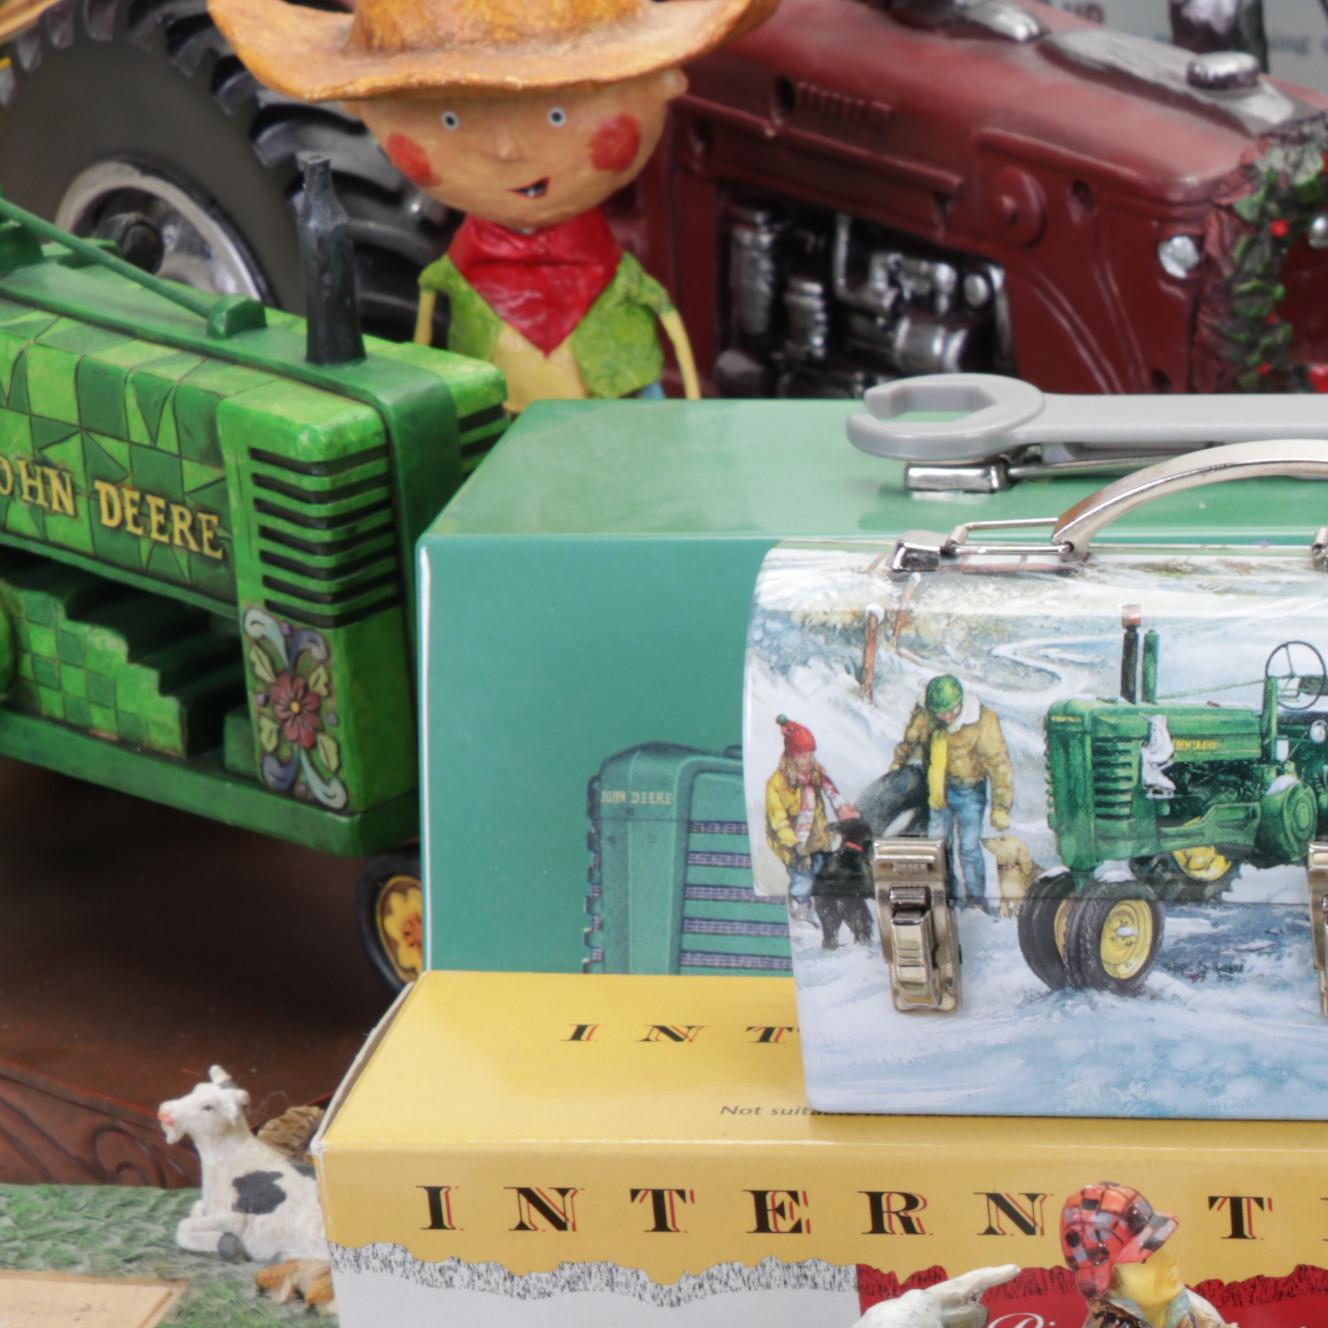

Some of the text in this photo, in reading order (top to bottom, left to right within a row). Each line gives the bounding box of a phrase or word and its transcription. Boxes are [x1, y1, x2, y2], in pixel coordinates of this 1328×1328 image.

[0, 455, 224, 560] OHN DEERE
[719, 1105, 763, 1116] Not
